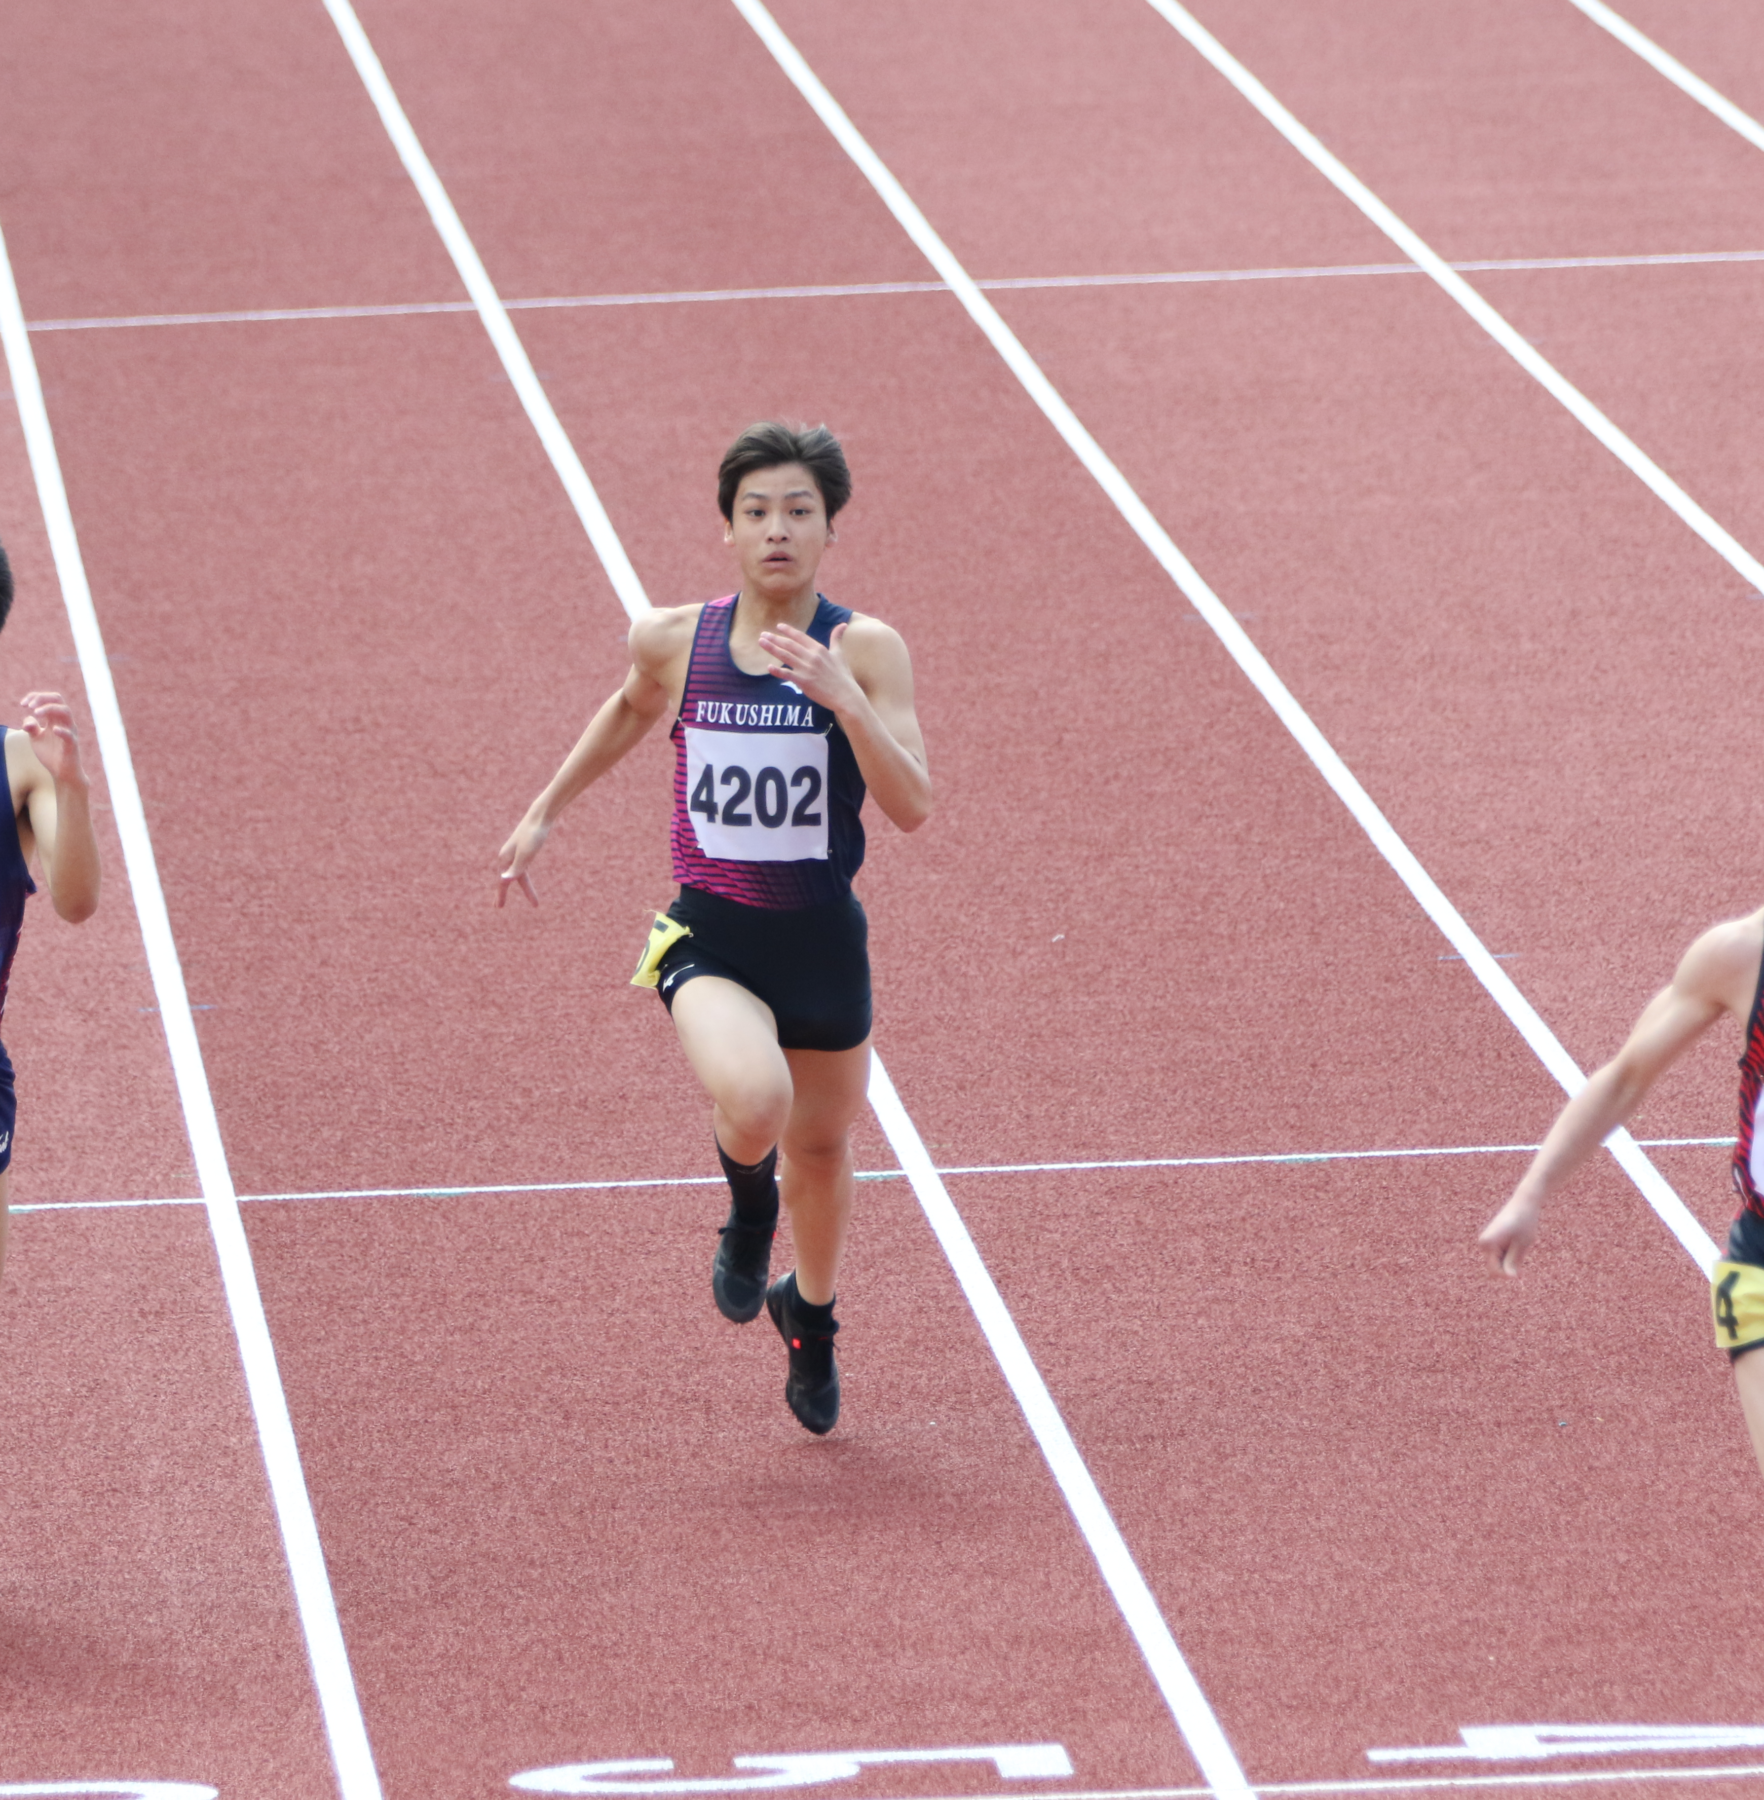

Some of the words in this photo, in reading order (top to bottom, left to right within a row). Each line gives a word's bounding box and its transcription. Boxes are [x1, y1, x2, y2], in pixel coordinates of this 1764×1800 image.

[695, 700, 814, 727] FUKUSHIMA
[690, 764, 822, 828] 4202
[1715, 1270, 1741, 1341] 4
[508, 1744, 1074, 1794] 5
